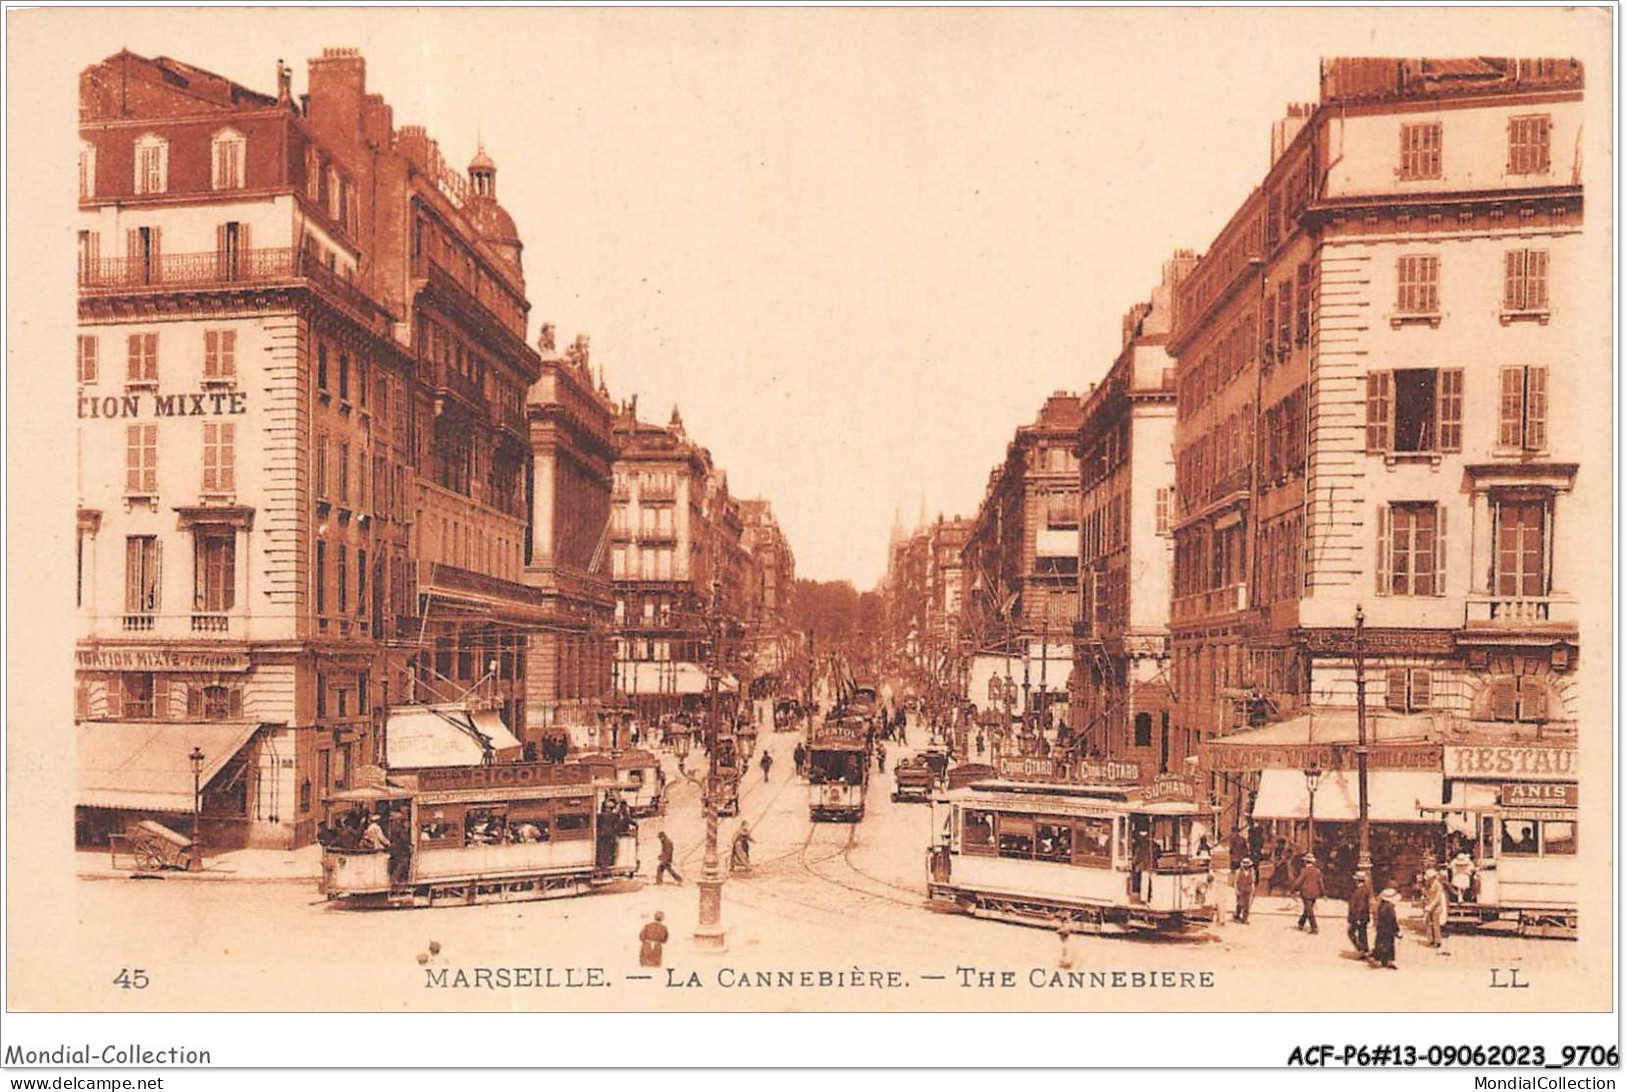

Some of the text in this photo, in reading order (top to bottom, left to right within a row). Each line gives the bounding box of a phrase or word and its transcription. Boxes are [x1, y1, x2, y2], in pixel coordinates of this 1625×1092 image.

[153, 391, 248, 417] MIXTE
[1025, 758, 1052, 776] OTARD
[1107, 761, 1138, 780] OTARD
[1453, 748, 1577, 774] RESTAU
[1145, 780, 1193, 800] SUCHARD
[1511, 785, 1566, 797] ANIS
